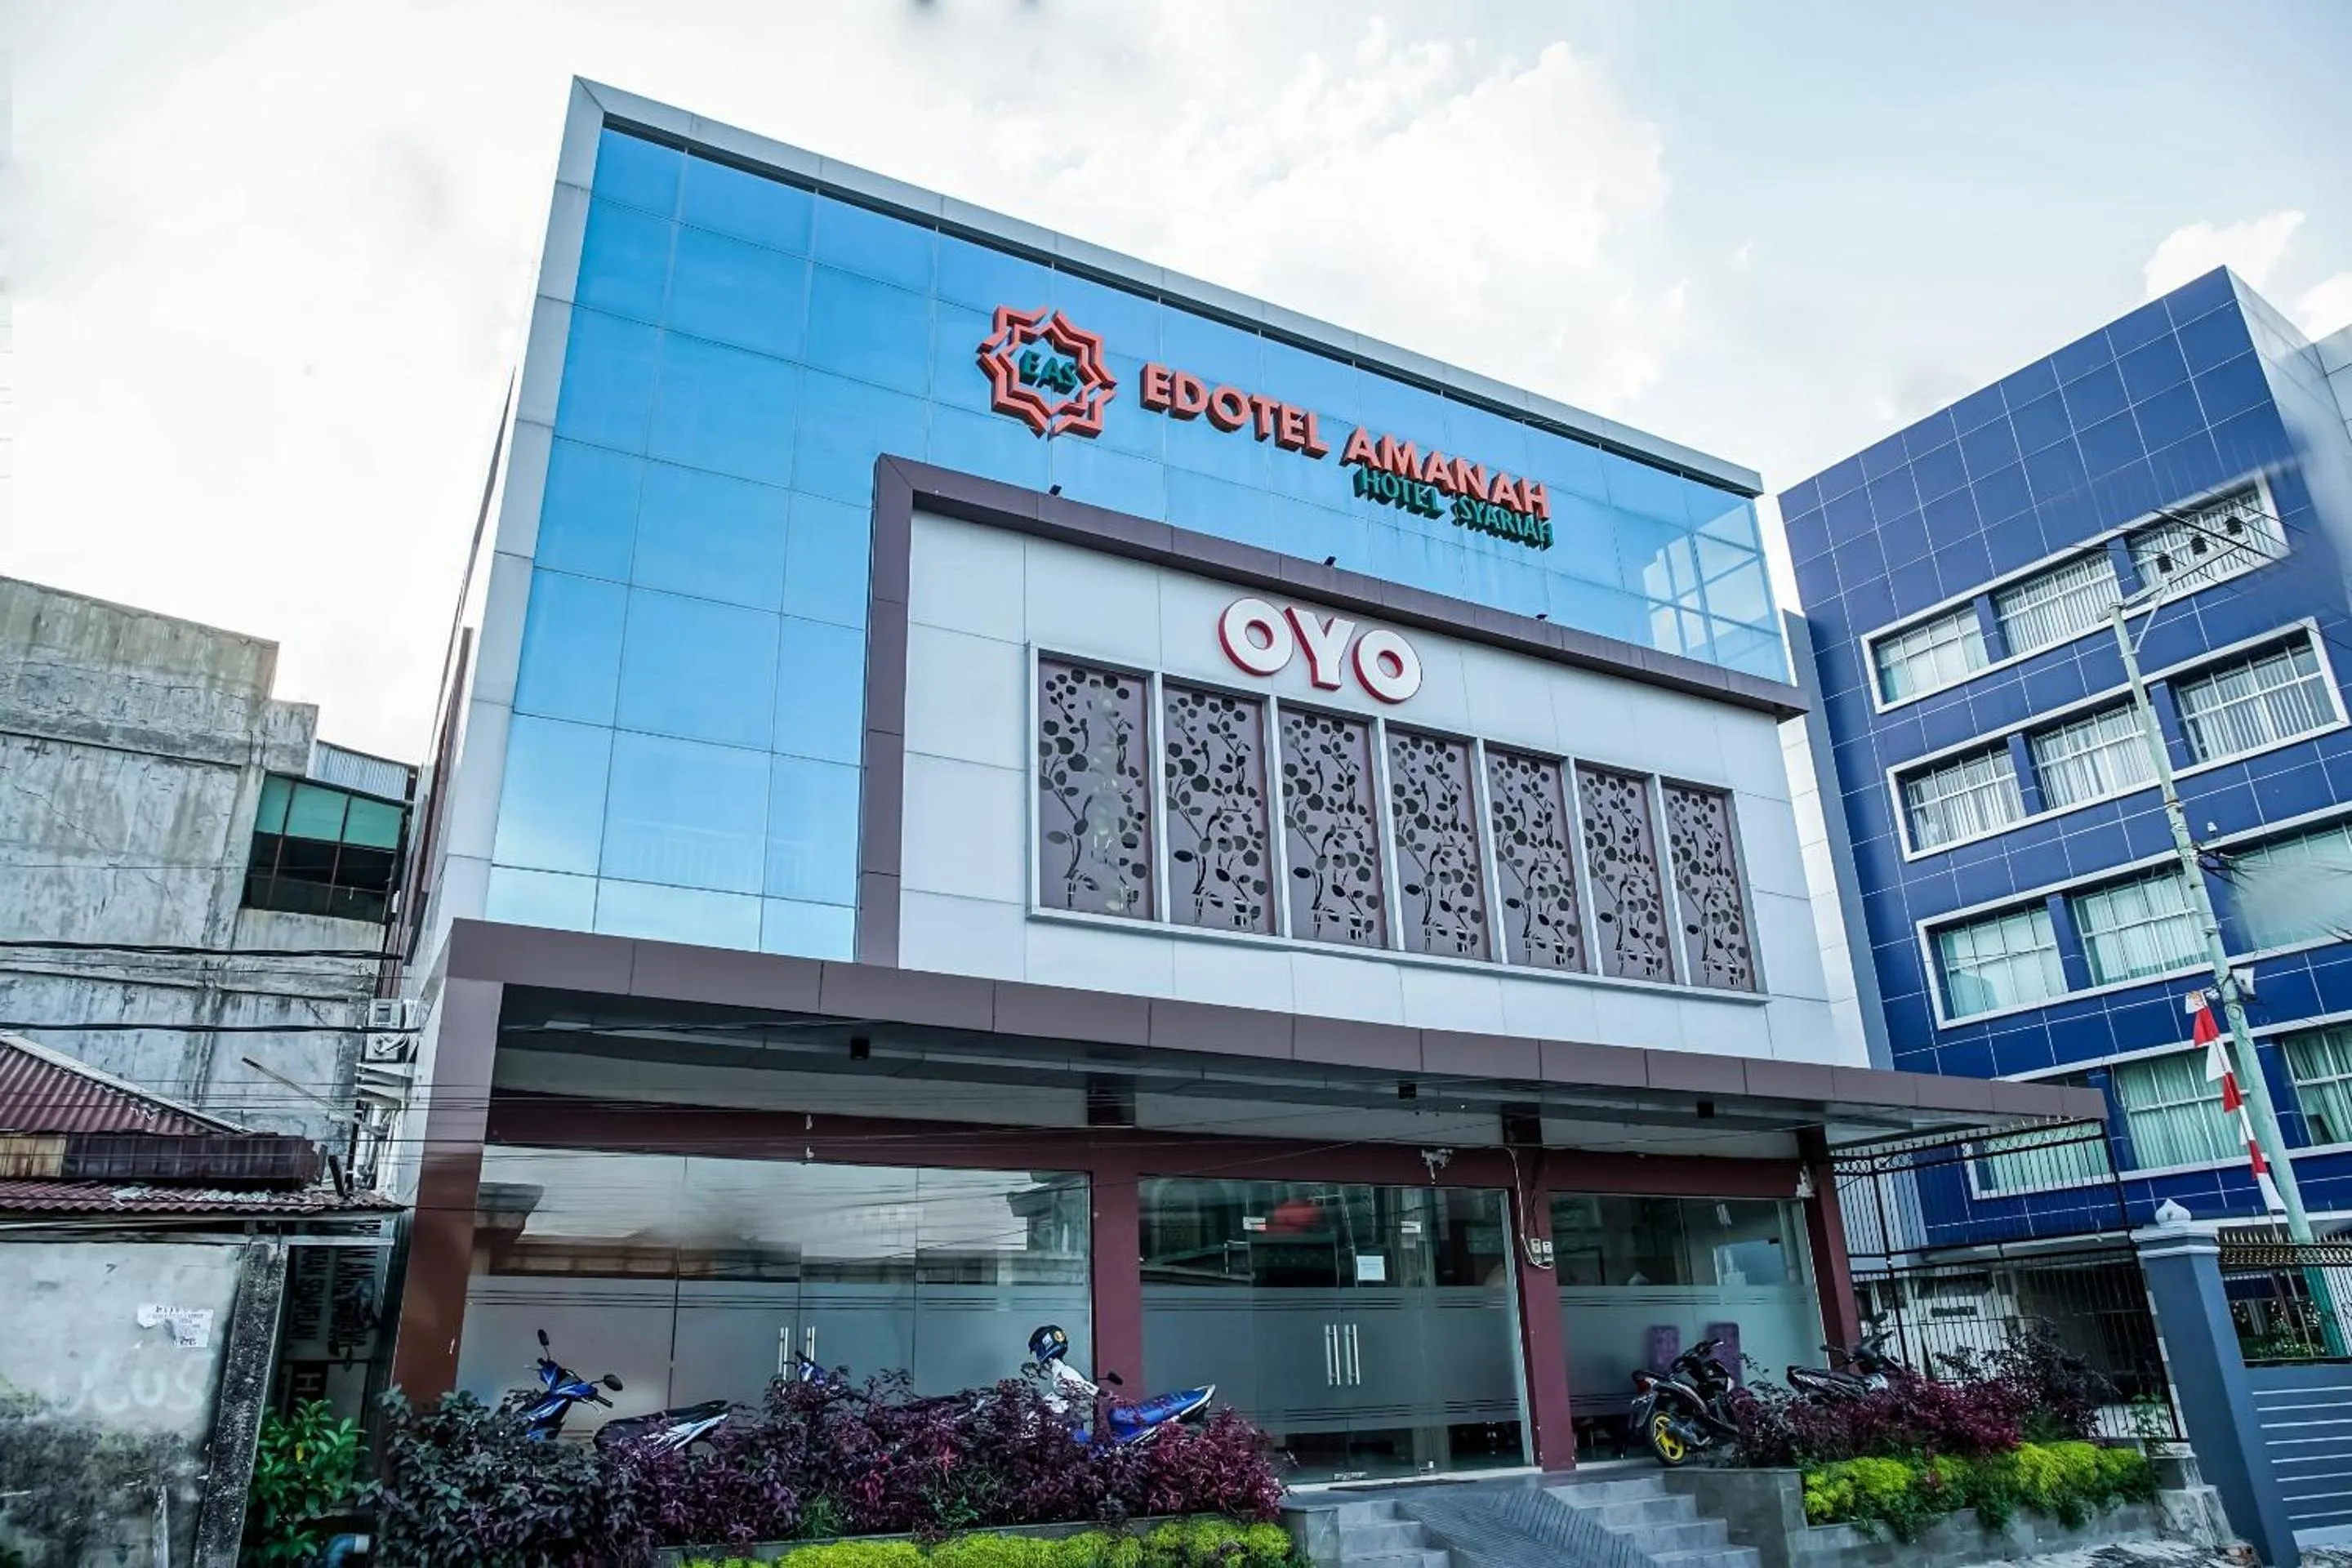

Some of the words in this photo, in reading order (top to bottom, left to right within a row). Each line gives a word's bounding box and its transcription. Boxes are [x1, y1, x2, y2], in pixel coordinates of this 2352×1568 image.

[1018, 350, 1078, 395] EAS
[1140, 362, 1330, 461] EDOTEL
[1339, 424, 1552, 521] AMANAH
[1352, 462, 1446, 520] HOTEL
[1450, 493, 1554, 551] SYARIAH
[1217, 596, 1423, 706] OYO
